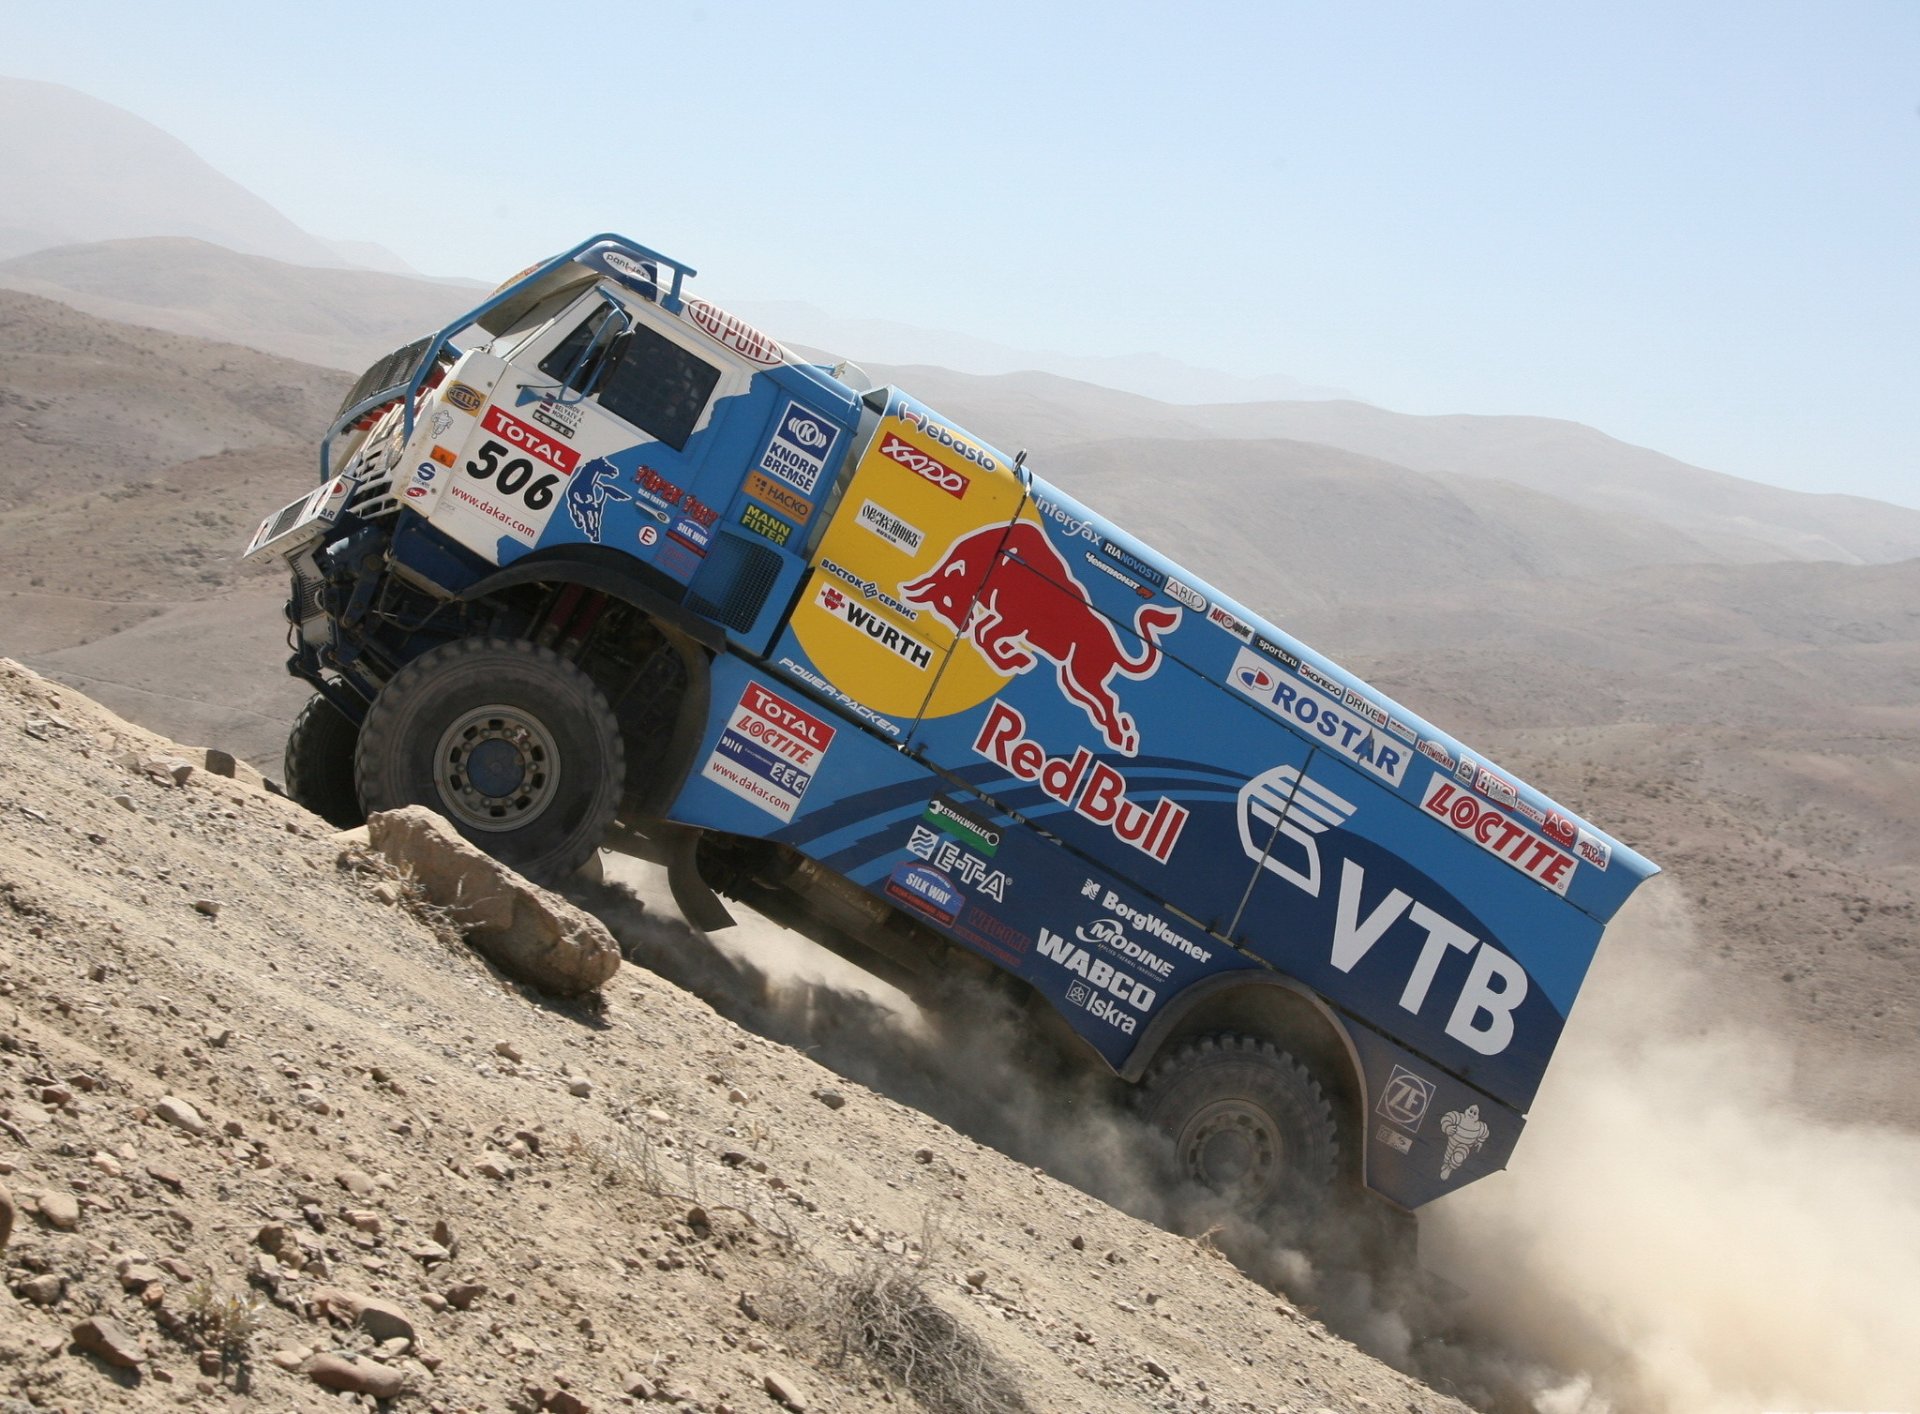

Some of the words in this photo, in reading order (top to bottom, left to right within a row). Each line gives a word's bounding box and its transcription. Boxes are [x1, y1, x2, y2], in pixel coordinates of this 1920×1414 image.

[722, 315, 777, 361] PONT
[449, 389, 481, 410] HELLA
[496, 412, 566, 468] TOTAL
[769, 442, 819, 479] KNORR
[898, 400, 998, 473] Webasto
[466, 440, 560, 510] 506
[763, 456, 814, 492] BREMSE
[881, 438, 963, 491] XADO
[452, 485, 535, 538] www.dakar.com
[677, 522, 694, 538] SILK
[692, 531, 708, 546] WAY
[742, 515, 788, 546] FILTER
[746, 505, 790, 537] MANN
[1035, 494, 1102, 546] interfax
[821, 558, 863, 590] ВОСТОК
[878, 593, 918, 621] СЕРВИС
[846, 602, 932, 669] WÜRTH
[1258, 638, 1298, 668] sports.ru
[755, 690, 820, 744] TOTAL
[778, 658, 901, 736] POWER-PACKER
[1345, 693, 1379, 721] DRIVE
[736, 715, 814, 765] LOCTITE
[1272, 682, 1400, 777] ROSTAR
[712, 762, 791, 812] www.dakar.com
[975, 702, 1092, 803] Red
[1077, 764, 1186, 861] Bull
[1426, 783, 1574, 885] LOCTITE
[1546, 813, 1574, 837] AG
[905, 872, 930, 894] SILK
[928, 883, 952, 905] WAY
[1090, 923, 1175, 978] MODINE
[1102, 890, 1212, 964] BorgWarner
[1036, 927, 1156, 1013] WABCO
[1330, 857, 1528, 1056] VTB
[1086, 991, 1137, 1035] Iskra
